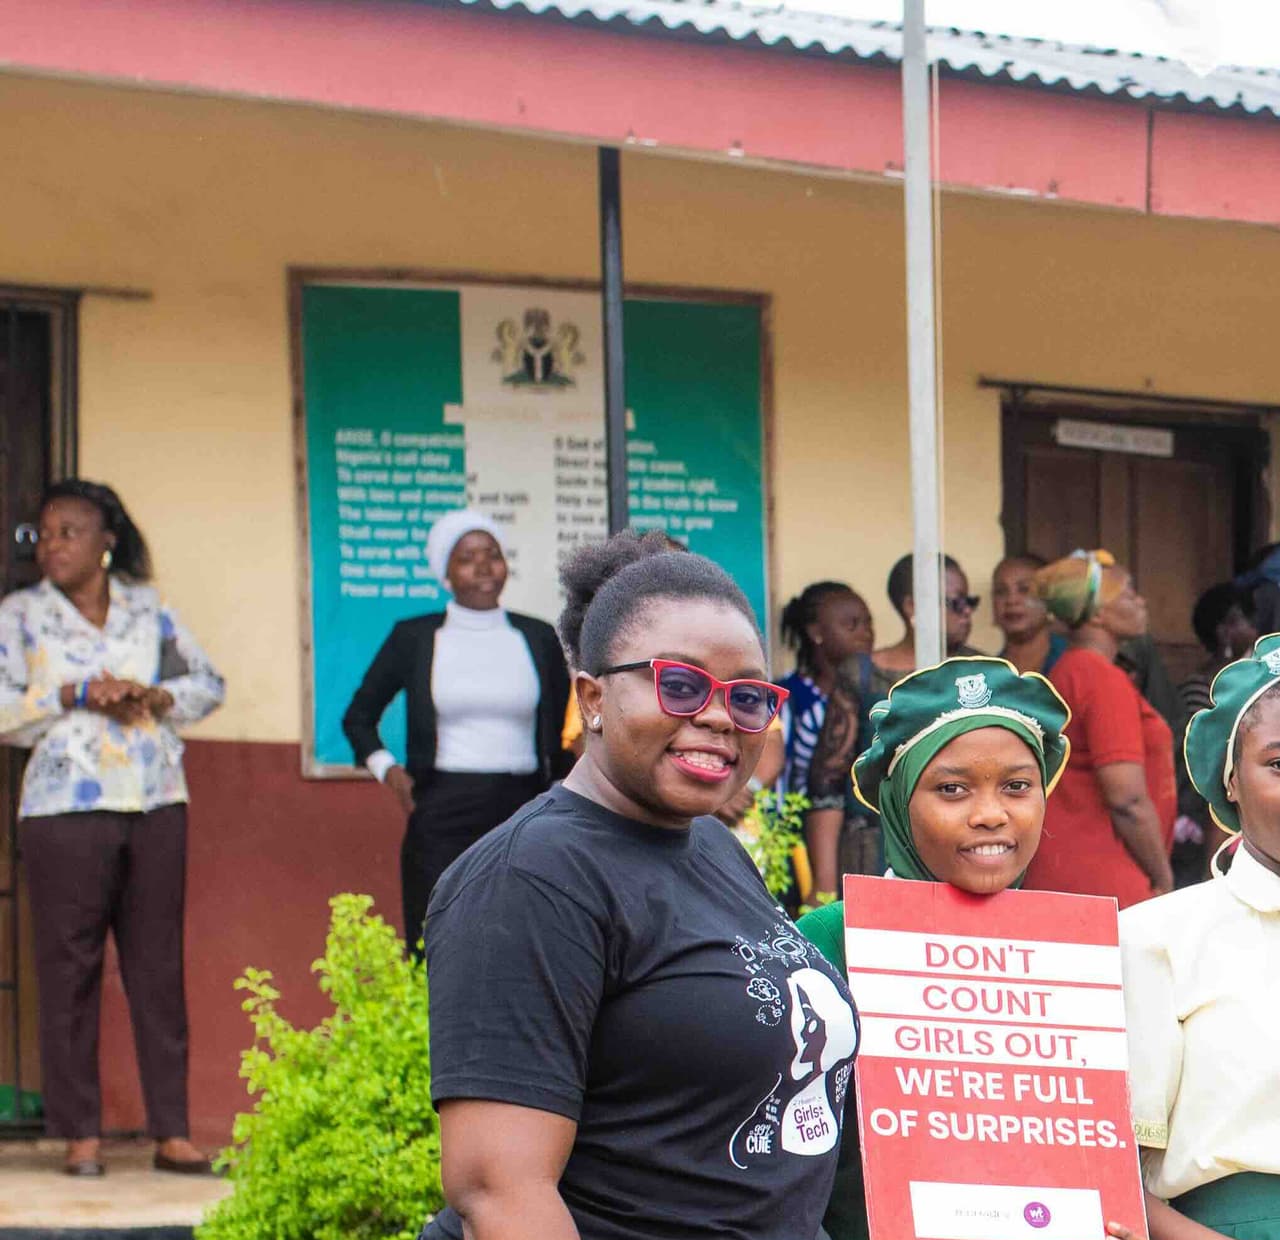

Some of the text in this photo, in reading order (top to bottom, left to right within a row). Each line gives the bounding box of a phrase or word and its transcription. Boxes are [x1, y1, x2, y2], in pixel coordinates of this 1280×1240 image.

[926, 942, 1035, 974] DON'T
[922, 985, 1052, 1017] COUNT
[895, 1025, 1087, 1067] GIRLS OUT,
[895, 1067, 1093, 1105] WE'RE FULL
[746, 1135, 771, 1154] CUTE
[797, 1119, 829, 1144] Tech
[870, 1109, 919, 1137] OF
[928, 1113, 1127, 1149] SURPRISES.
